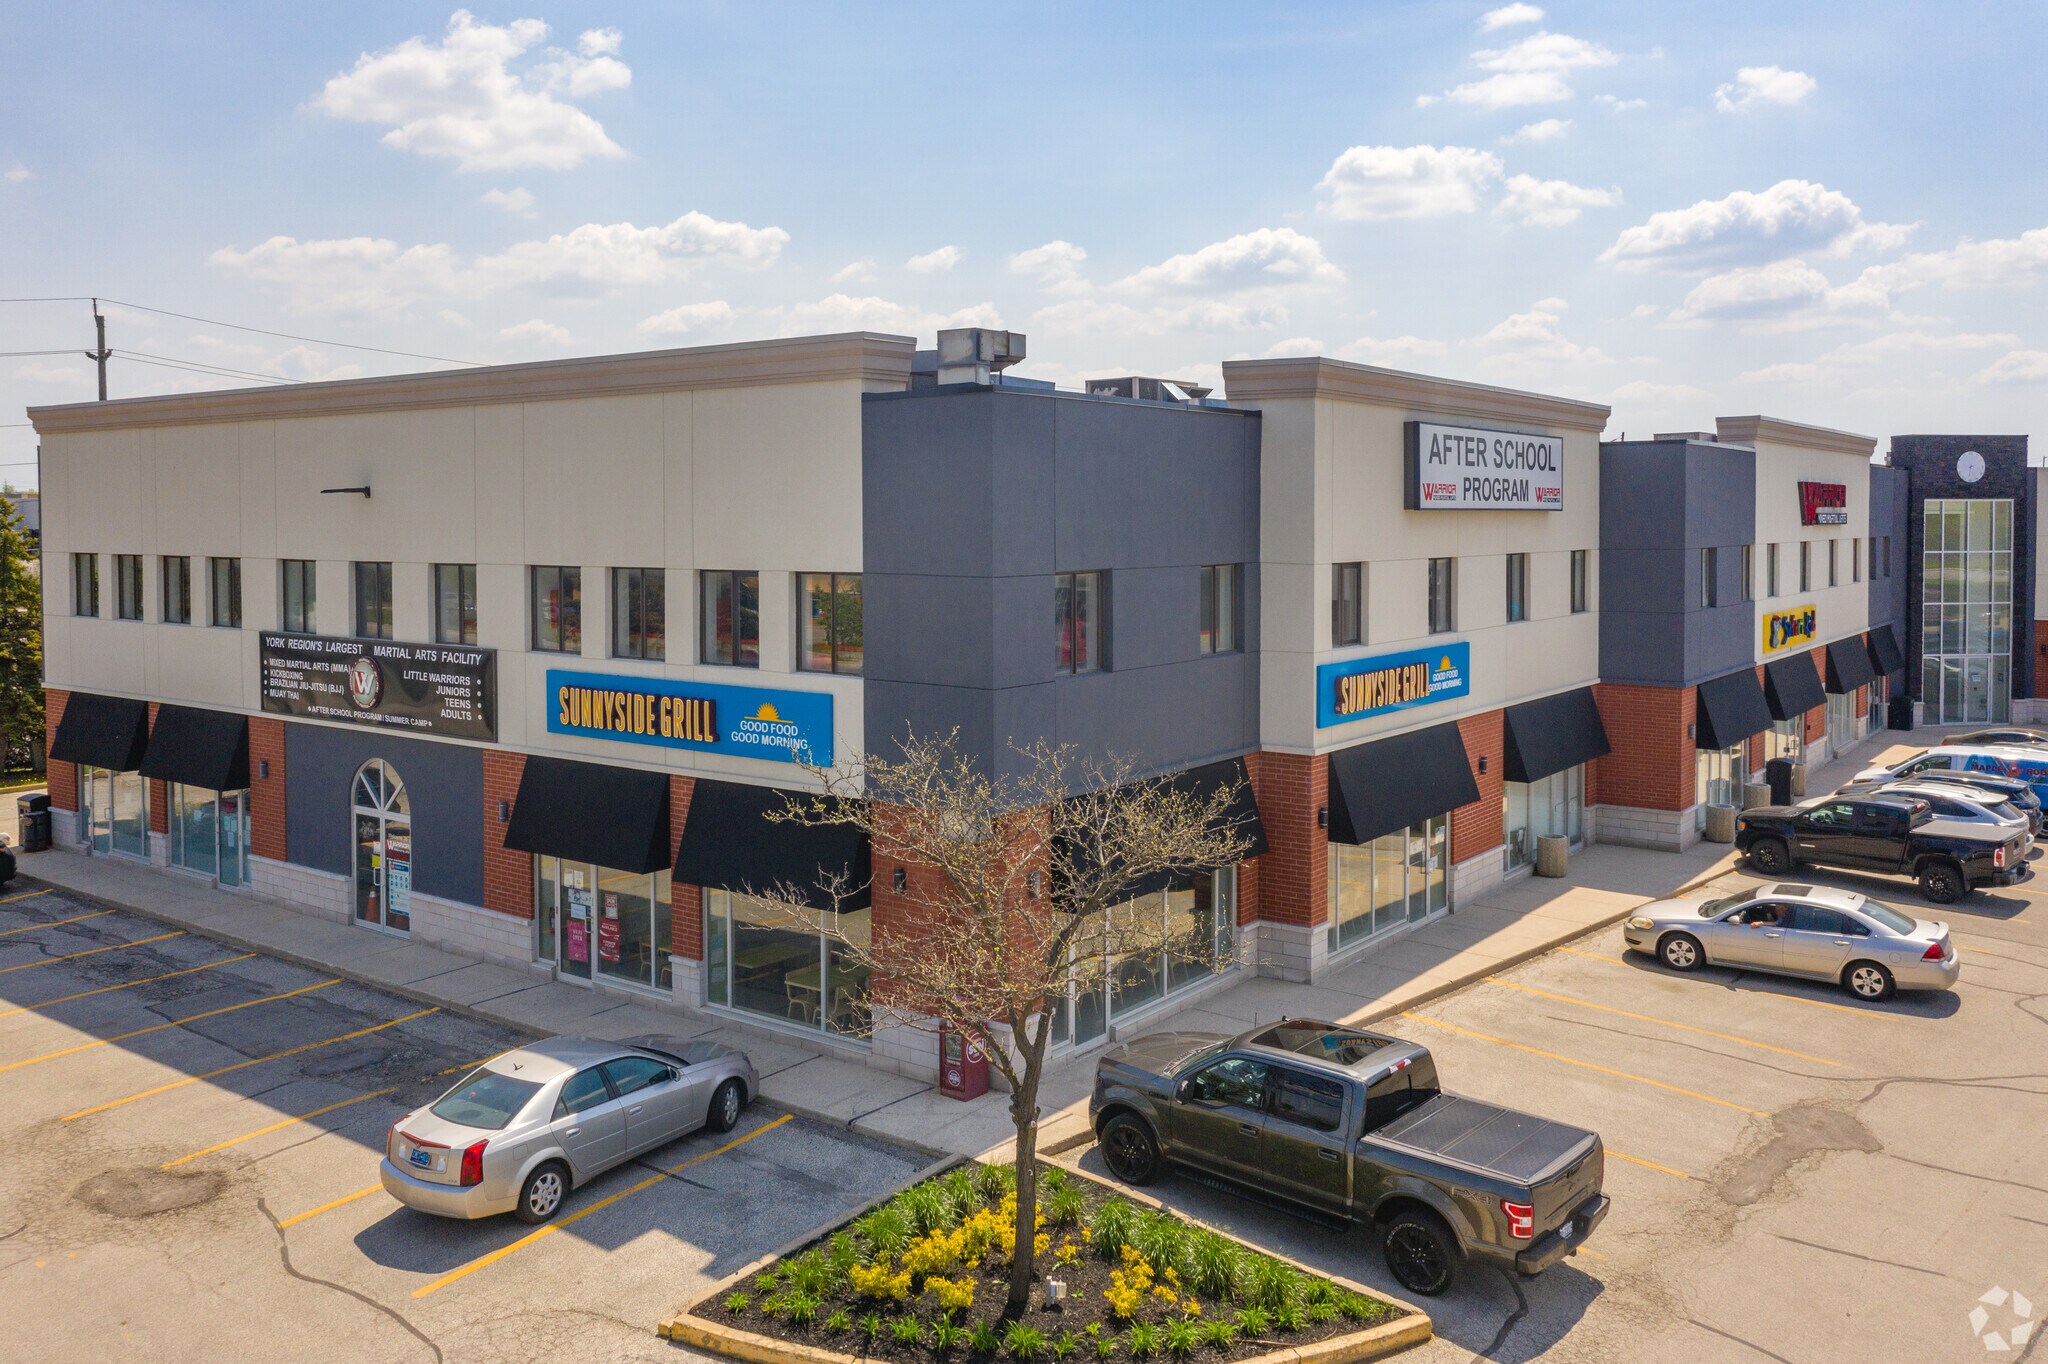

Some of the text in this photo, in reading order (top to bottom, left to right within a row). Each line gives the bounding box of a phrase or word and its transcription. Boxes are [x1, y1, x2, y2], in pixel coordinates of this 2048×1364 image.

[1428, 433, 1556, 472] AFTER SCHOOL
[1422, 483, 1456, 501] WARRIOR
[1463, 477, 1529, 502] PROGRAM
[1534, 486, 1561, 502] WARRIOR
[265, 637, 482, 665] YORK REGION'S LARGEST MARTIAL ARTS FACILITY
[269, 658, 351, 675] MIXED MARTIAL ARTS (MMA)
[269, 669, 304, 680] KICKBOXING
[403, 670, 471, 686] LITTLE WARRIORS
[1432, 669, 1459, 682] GOOD FOOD
[269, 679, 345, 695] BRAZILIAN JIU-JITSU (BJJ)
[435, 685, 471, 697] JUNIORS
[1341, 662, 1431, 715] SUNNYSIDE GRILL
[1429, 678, 1462, 692] GOOD MORNING
[269, 689, 300, 700] MUAY THAI
[444, 697, 471, 709] TEENS
[311, 706, 428, 727] AFTER SCHOOL PROGRAM SUMMER CAMP
[440, 708, 472, 721] ADULTS
[558, 686, 715, 743] SUNNYSIDE GRILL
[740, 720, 799, 737] GOOD FOOD
[731, 731, 808, 750] GOOD MORNING
[1971, 763, 2005, 773] MAPLE
